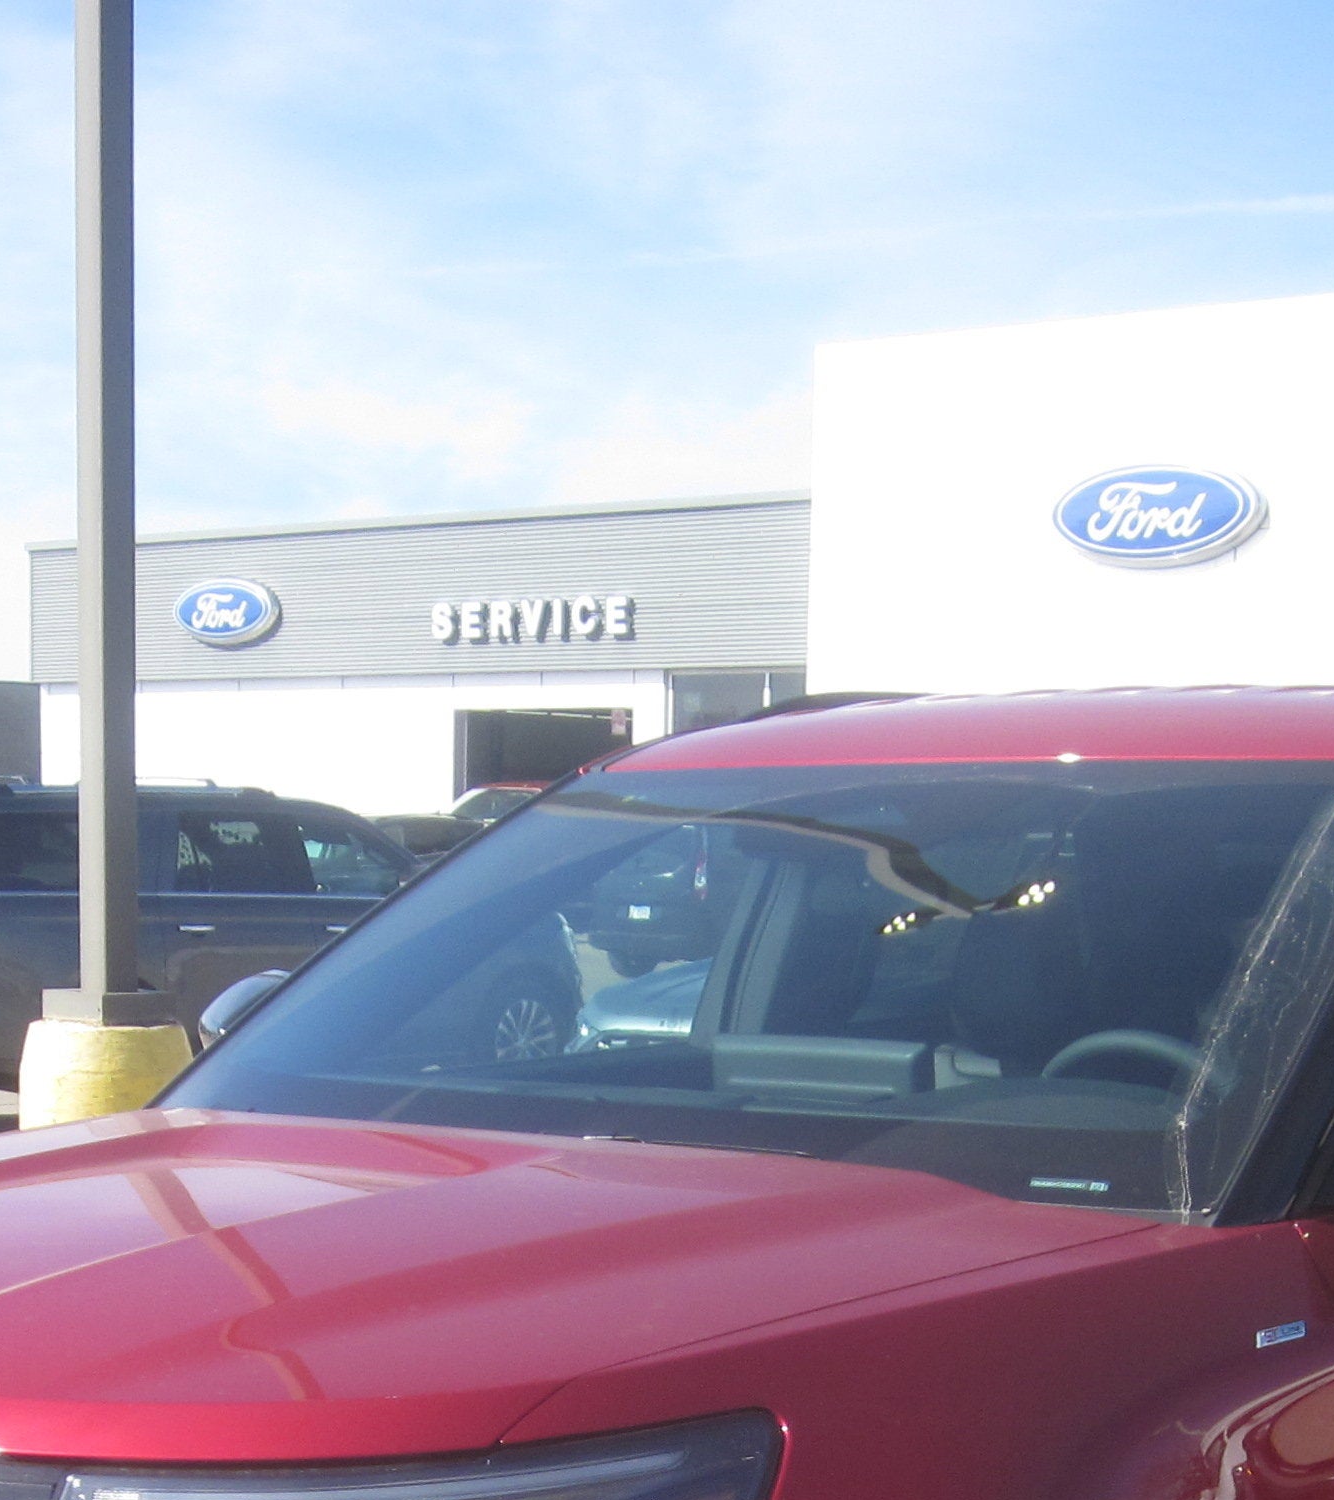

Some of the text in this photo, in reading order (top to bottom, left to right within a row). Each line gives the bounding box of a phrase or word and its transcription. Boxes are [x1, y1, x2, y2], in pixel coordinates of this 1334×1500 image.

[1087, 481, 1207, 542] Ford
[191, 593, 247, 629] Ford
[431, 595, 628, 640] SERVICE
